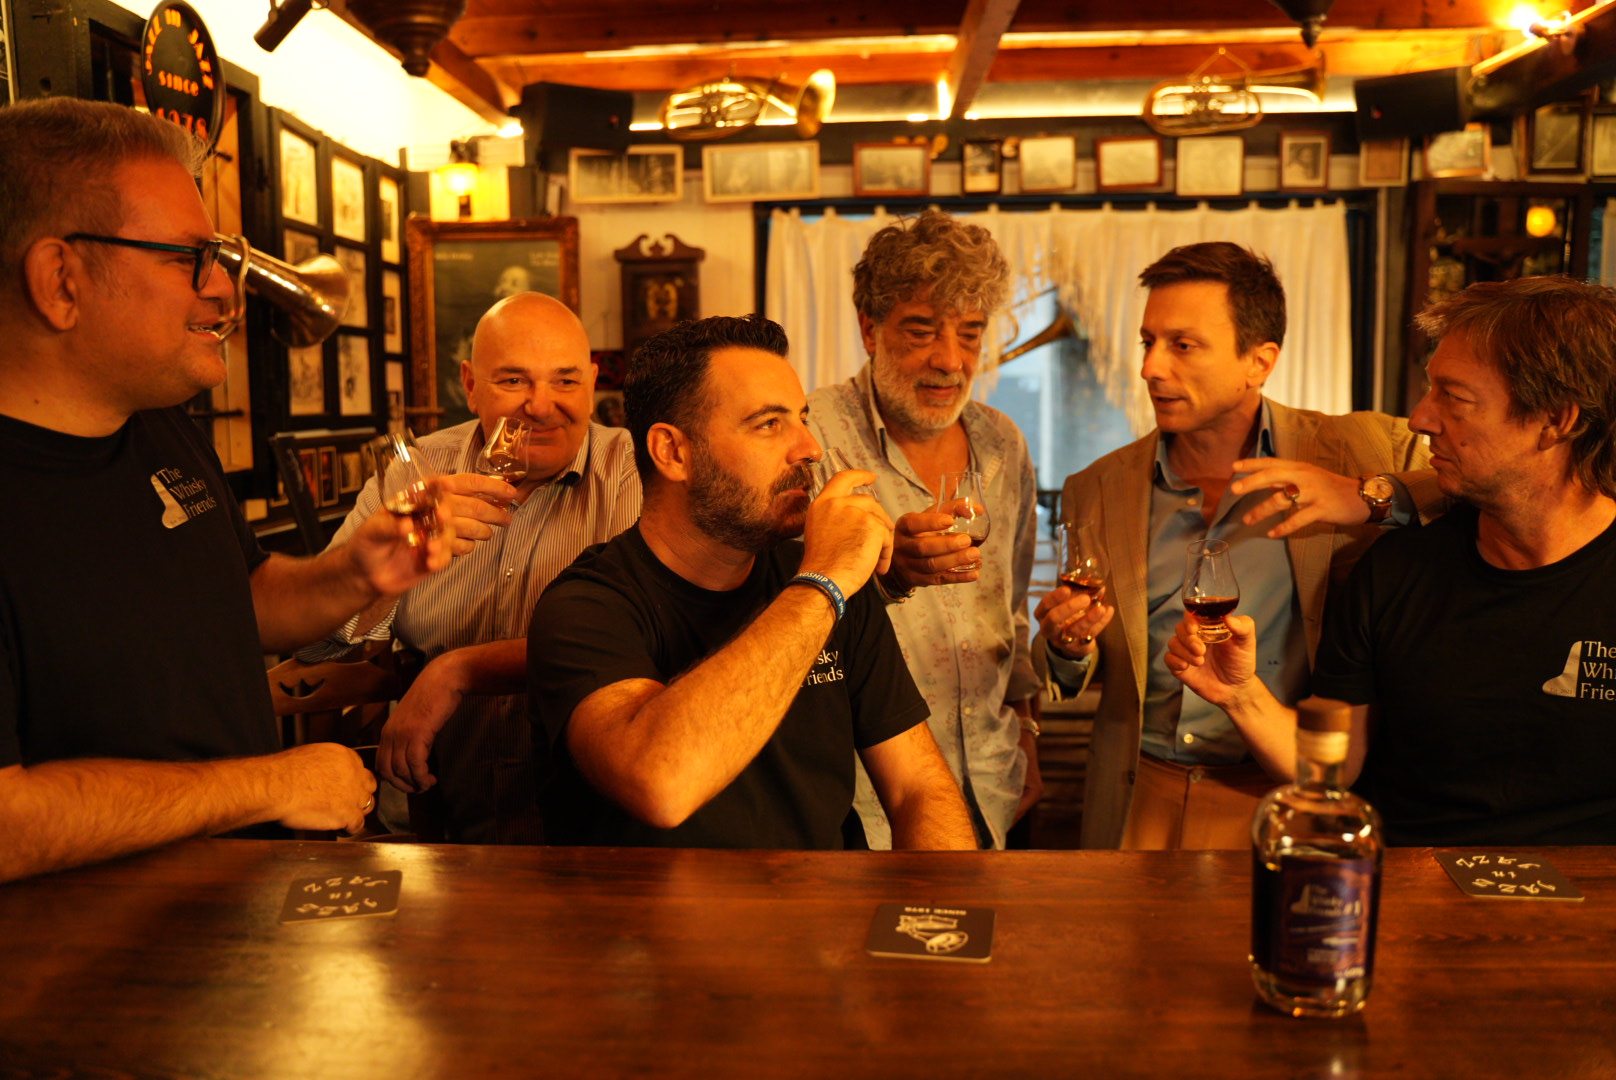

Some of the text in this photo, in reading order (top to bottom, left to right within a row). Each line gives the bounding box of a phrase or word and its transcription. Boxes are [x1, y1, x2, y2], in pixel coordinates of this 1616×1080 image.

[156, 467, 183, 484] The
[169, 477, 209, 502] Whisky
[183, 494, 217, 518] Friends
[815, 649, 839, 666] sky
[1584, 641, 1616, 659] The
[801, 666, 844, 687] riends
[1580, 682, 1616, 701] Frie
